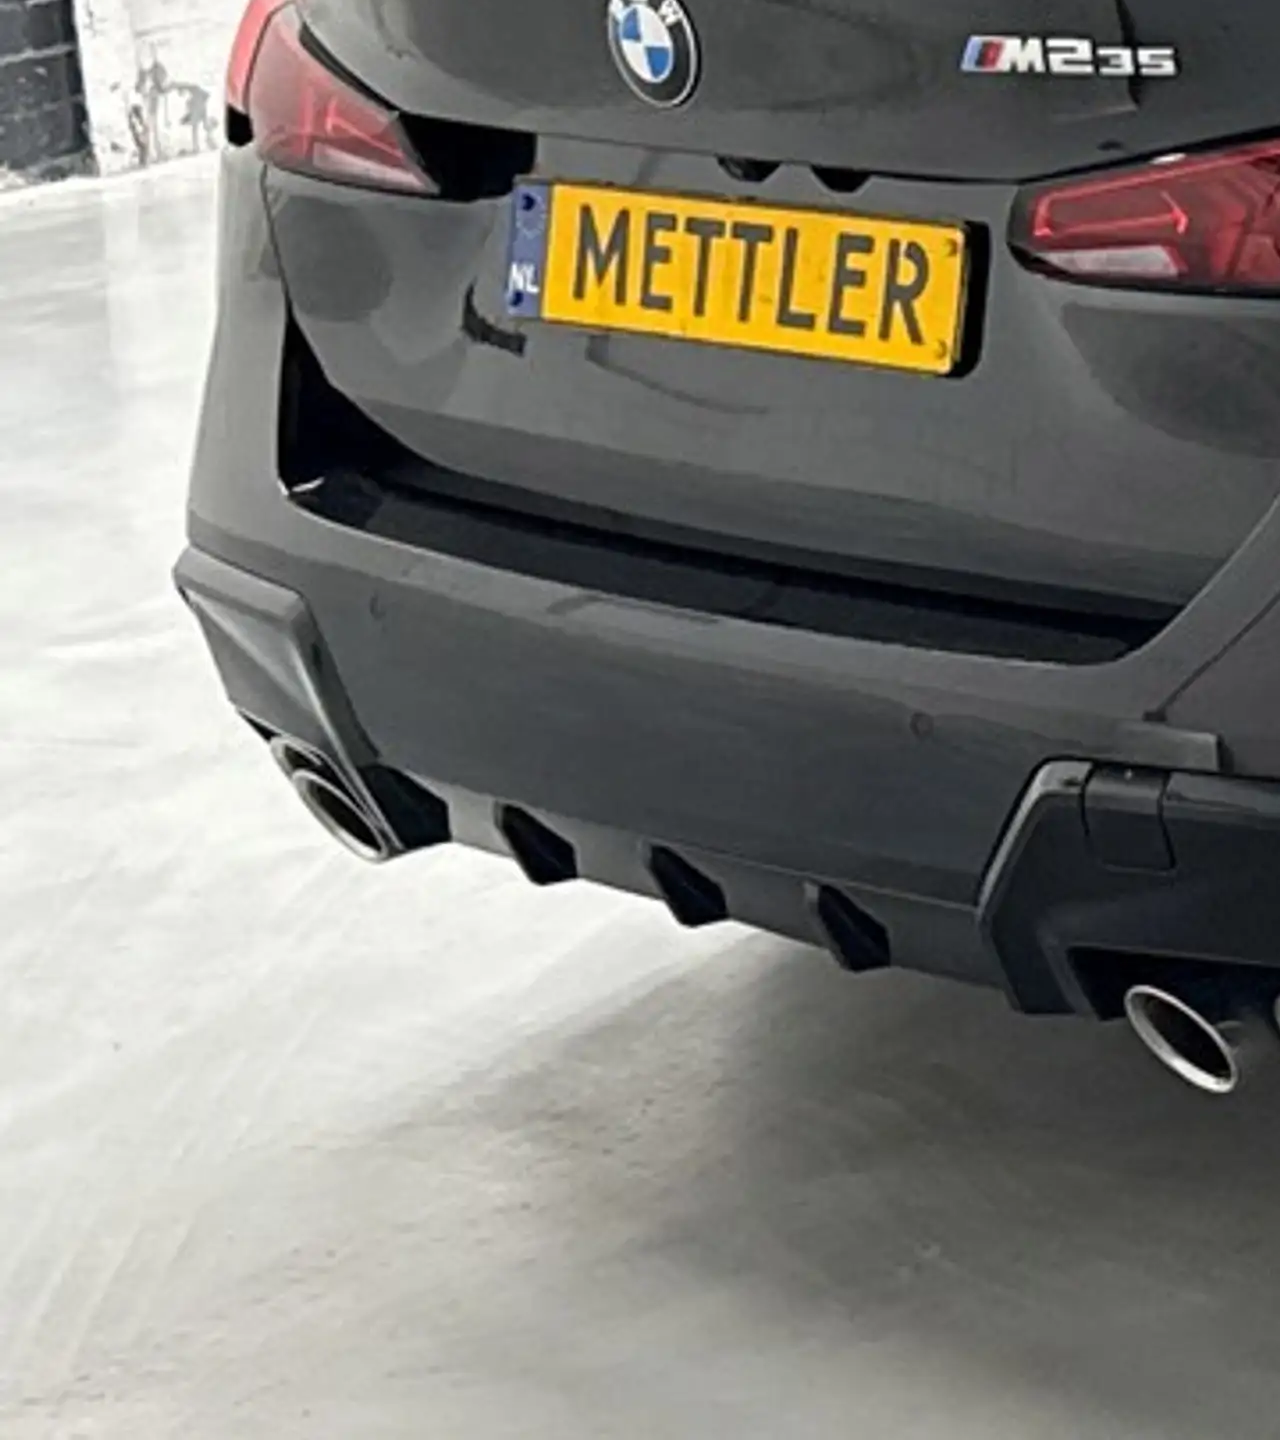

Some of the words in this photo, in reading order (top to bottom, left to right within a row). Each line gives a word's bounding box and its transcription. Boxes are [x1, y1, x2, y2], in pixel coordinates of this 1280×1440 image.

[1001, 36, 1178, 76] M235
[508, 262, 540, 295] NL
[572, 203, 931, 347] METTLER
